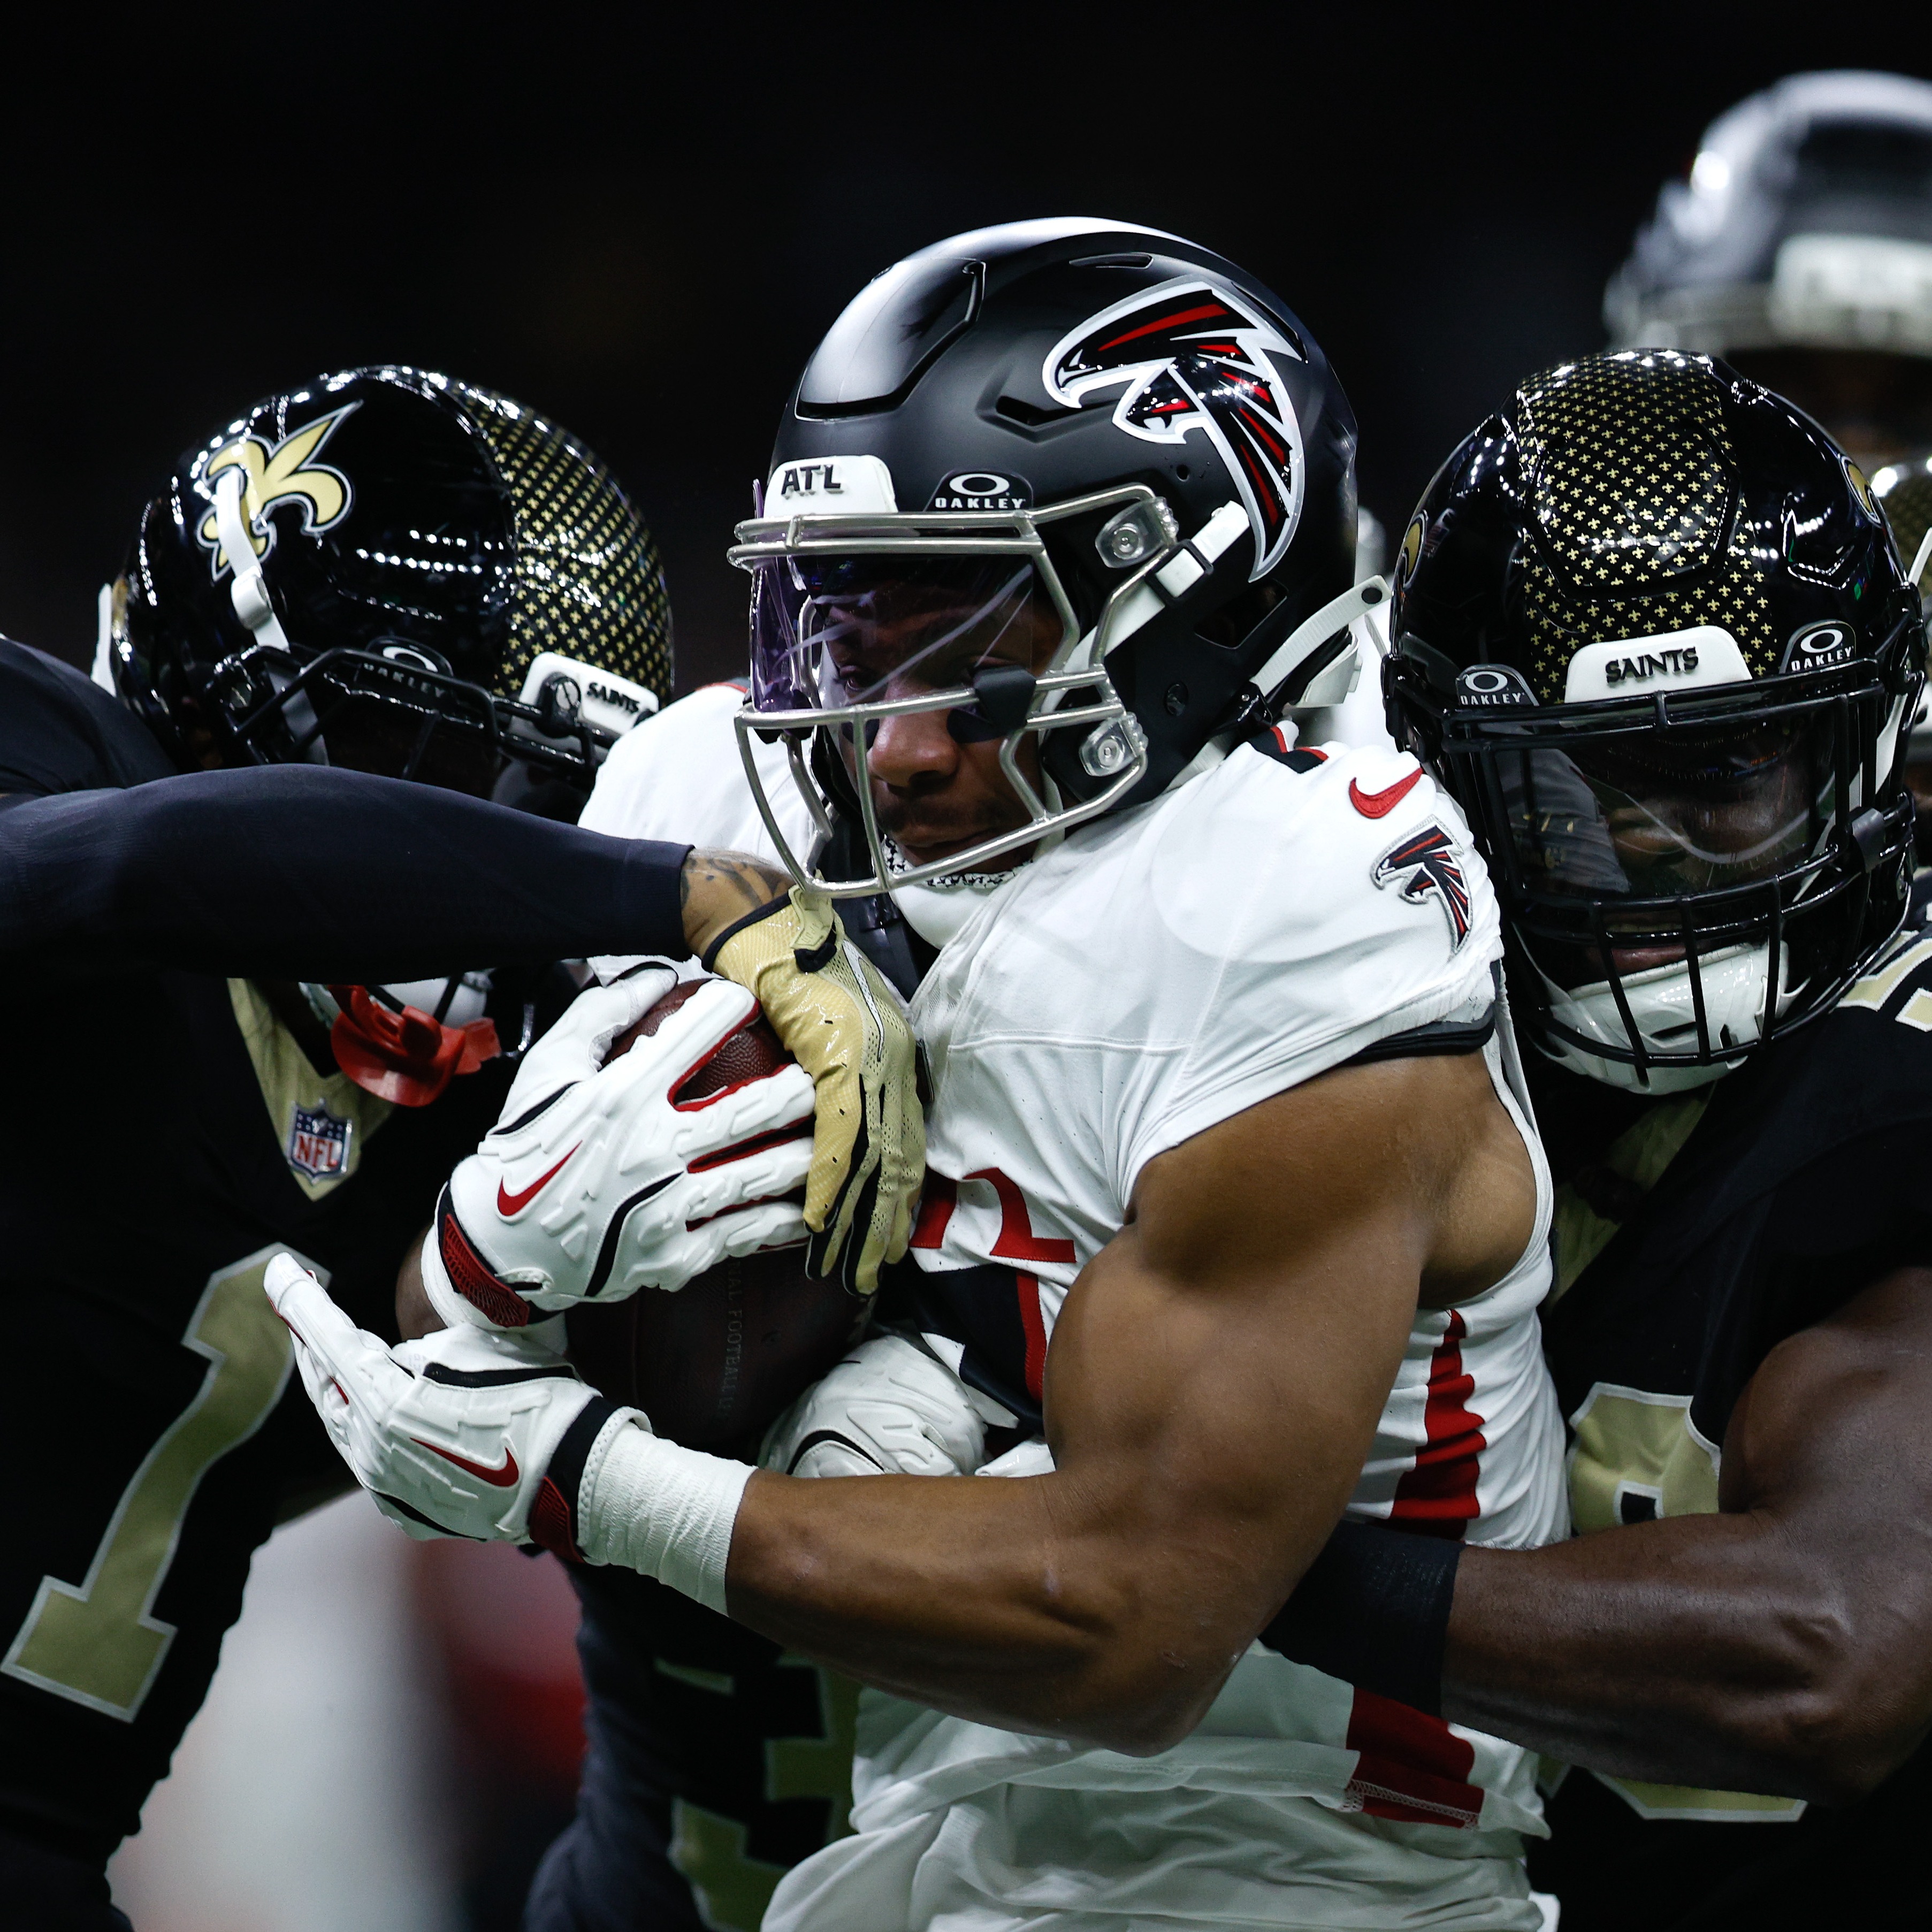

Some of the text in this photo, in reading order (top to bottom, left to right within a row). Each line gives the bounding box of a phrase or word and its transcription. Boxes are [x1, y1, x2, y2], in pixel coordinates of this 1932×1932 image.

[781, 464, 841, 495] ATL
[935, 497, 1023, 509] OAKLEY
[1605, 646, 1699, 683] SAINTS
[1791, 646, 1853, 671] OAKLEY
[587, 682, 640, 713] SAINTS
[1460, 692, 1522, 706] OAKLEY
[294, 1135, 338, 1169] NFL
[722, 1309, 743, 1393] FOOTBALL
[0, 1241, 333, 1724] 1
